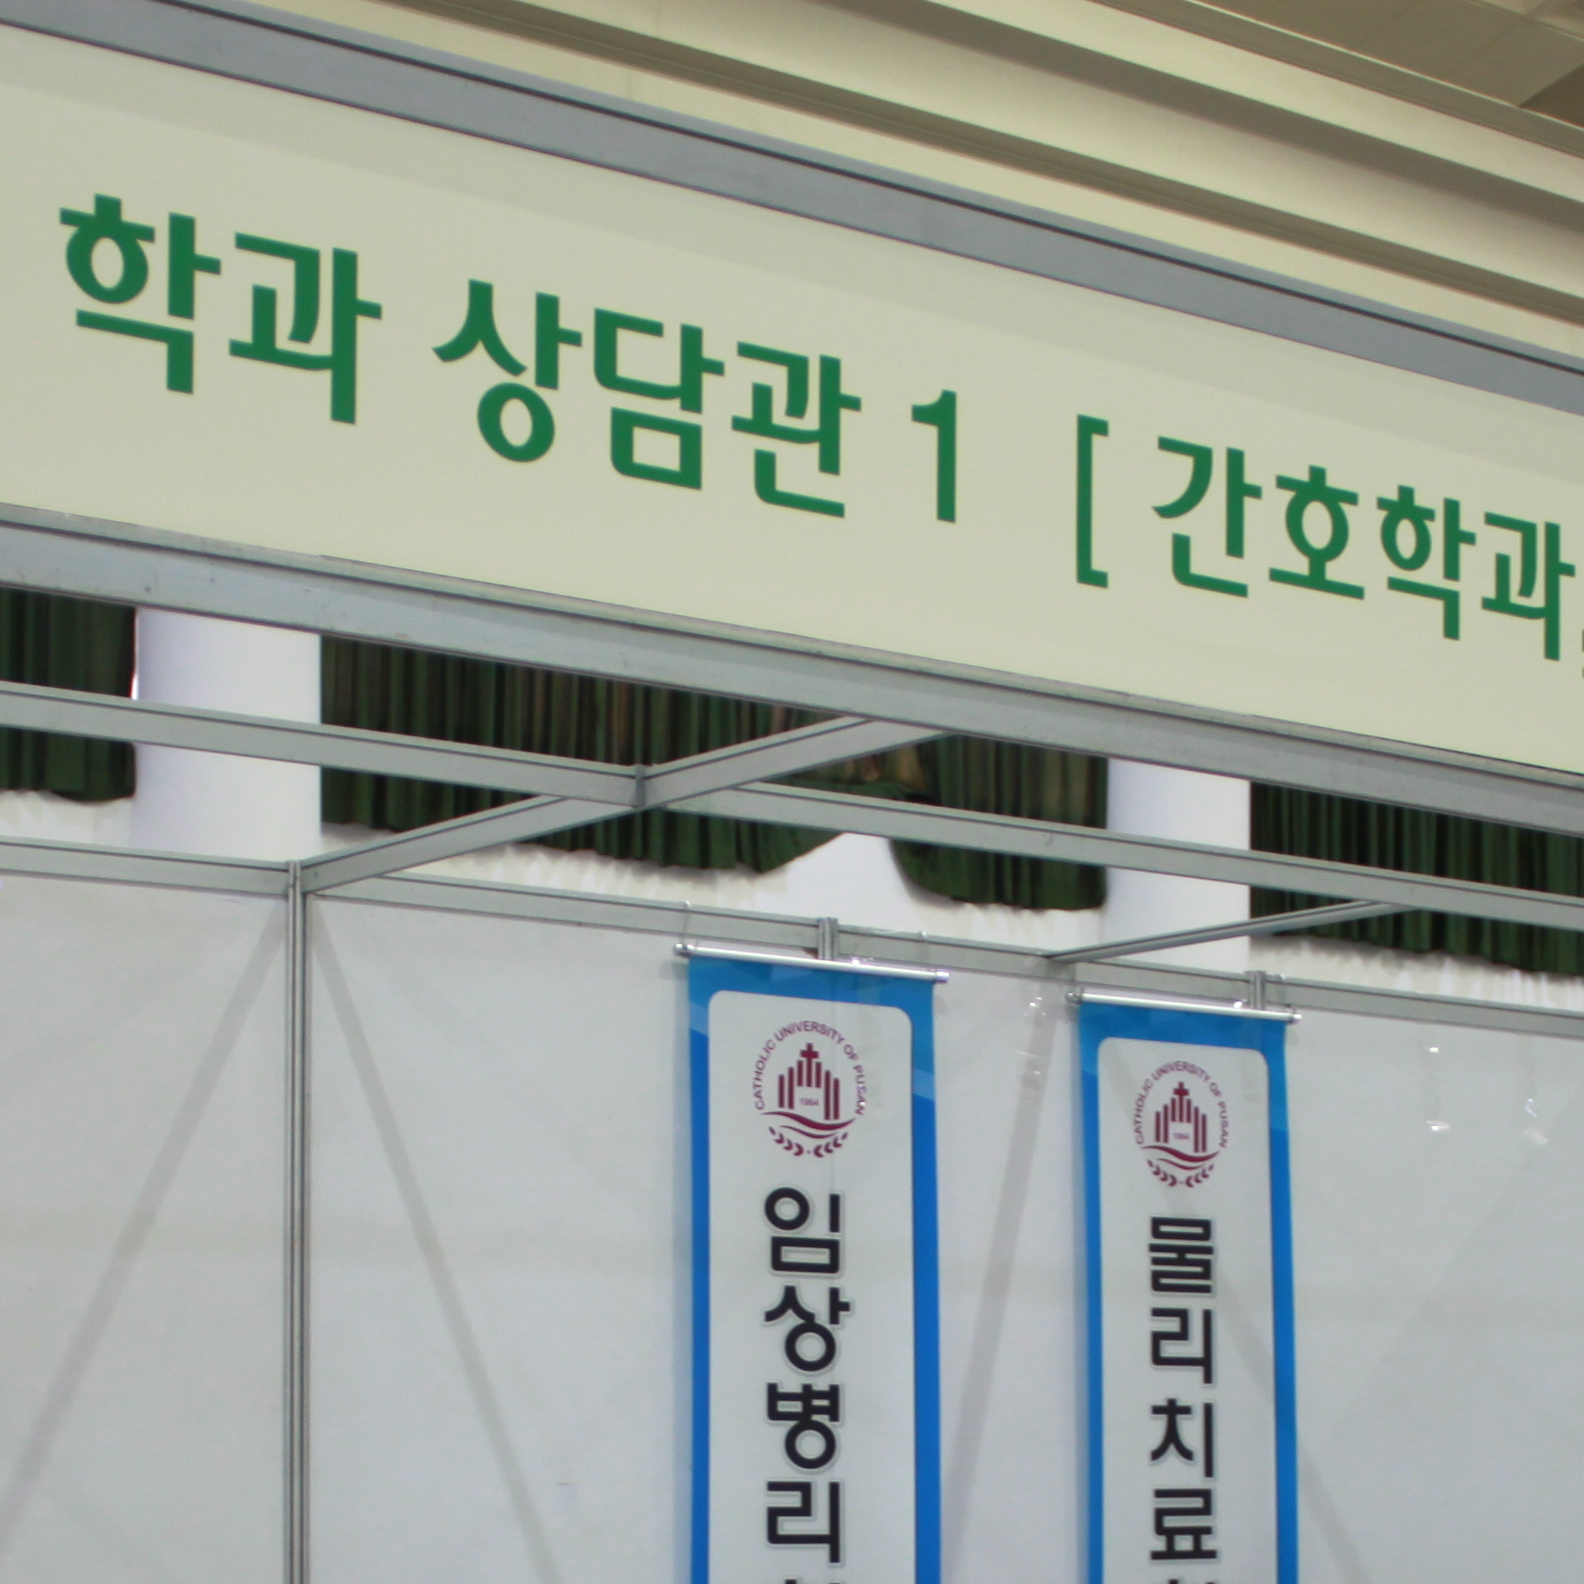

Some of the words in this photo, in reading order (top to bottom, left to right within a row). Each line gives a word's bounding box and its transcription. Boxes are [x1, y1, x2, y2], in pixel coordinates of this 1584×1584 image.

[59, 194, 382, 425] 학과
[432, 278, 862, 518] 상담관
[911, 389, 957, 523] 1
[752, 1039, 776, 1110] CATHOLIC
[774, 1020, 845, 1045] UNIVERSITY
